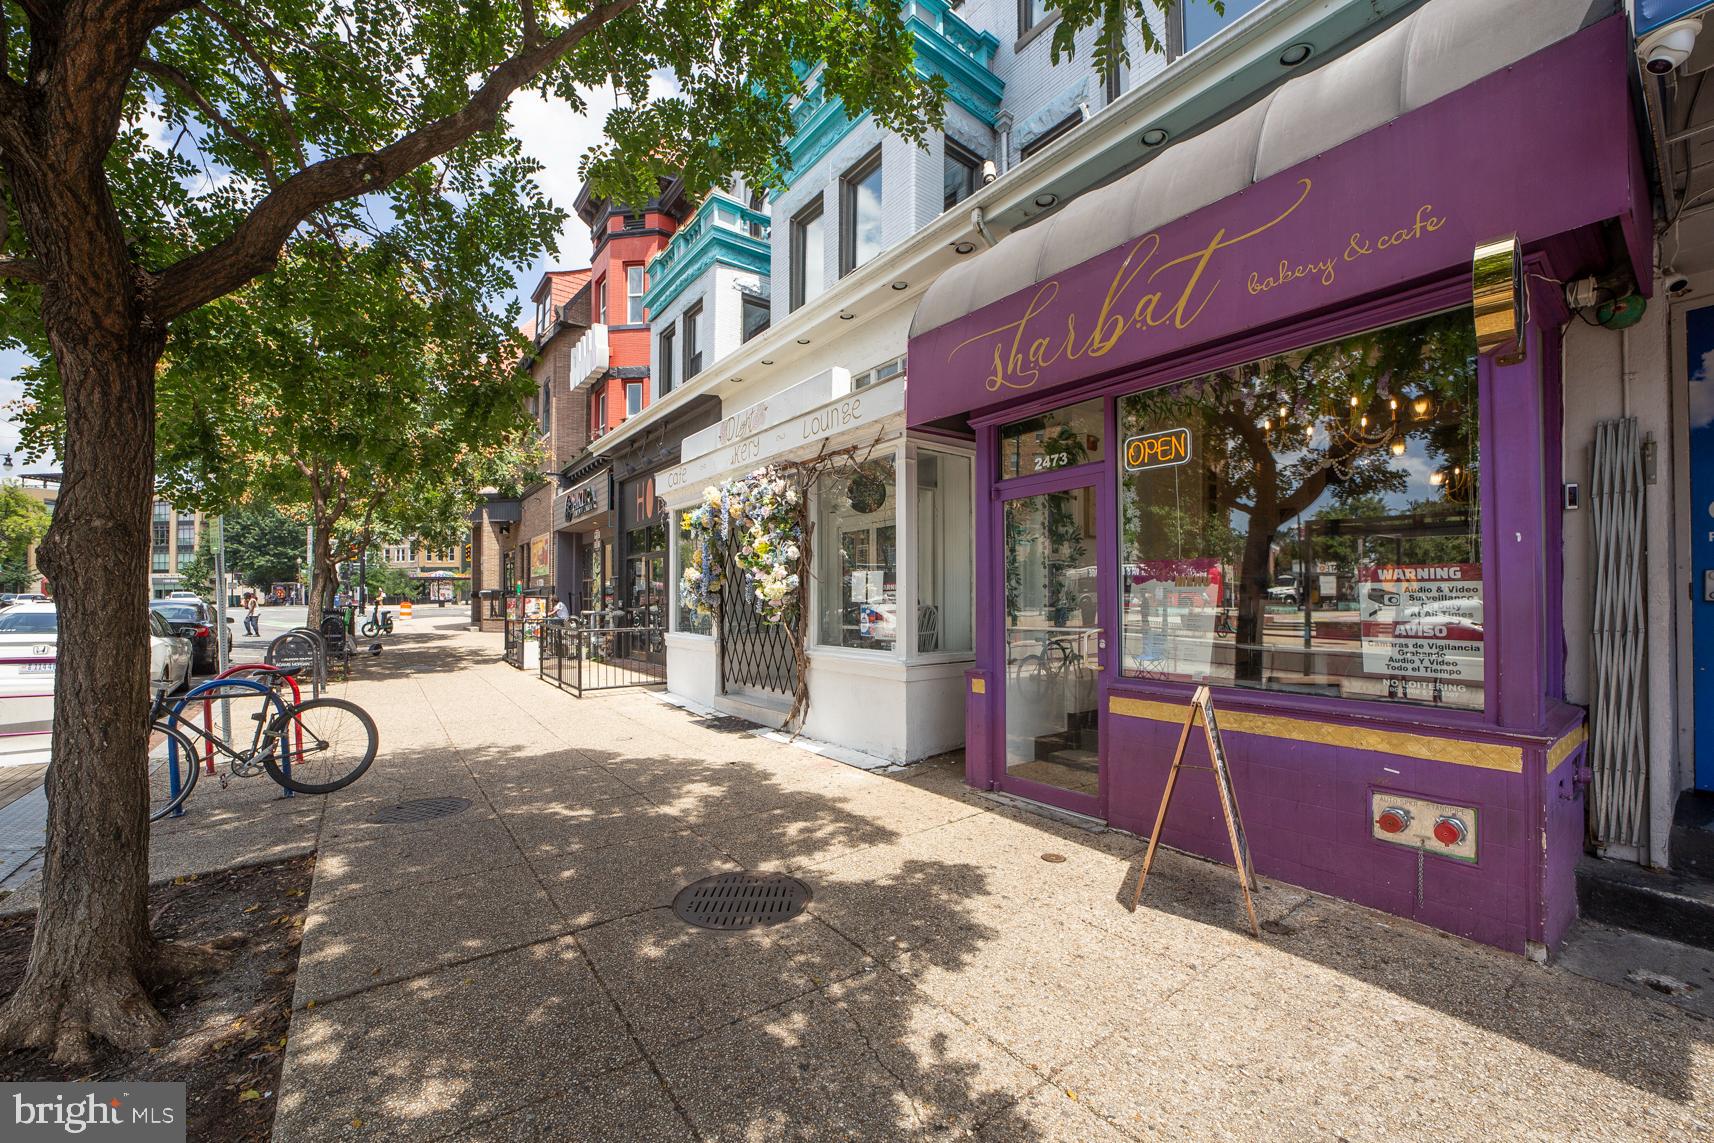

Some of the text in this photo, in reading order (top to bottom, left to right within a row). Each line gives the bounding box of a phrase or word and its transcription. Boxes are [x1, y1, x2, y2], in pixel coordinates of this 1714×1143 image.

[1248, 204, 1447, 294] bakery & cafe
[1128, 433, 1186, 466] OPEN
[1034, 452, 1069, 471] 2473
[1377, 567, 1462, 580] WARNING
[1404, 586, 1433, 594] Audio
[1447, 585, 1479, 594] Video
[1394, 624, 1448, 637] AVISO
[1412, 642, 1425, 650] de
[1428, 642, 1481, 652] Vigilancia
[1388, 656, 1458, 667] Audio Y Video
[1385, 663, 1462, 676] Todo el Tiempo
[1382, 678, 1466, 692] NO LOITERING
[1426, 803, 1466, 816] STANDPIPE
